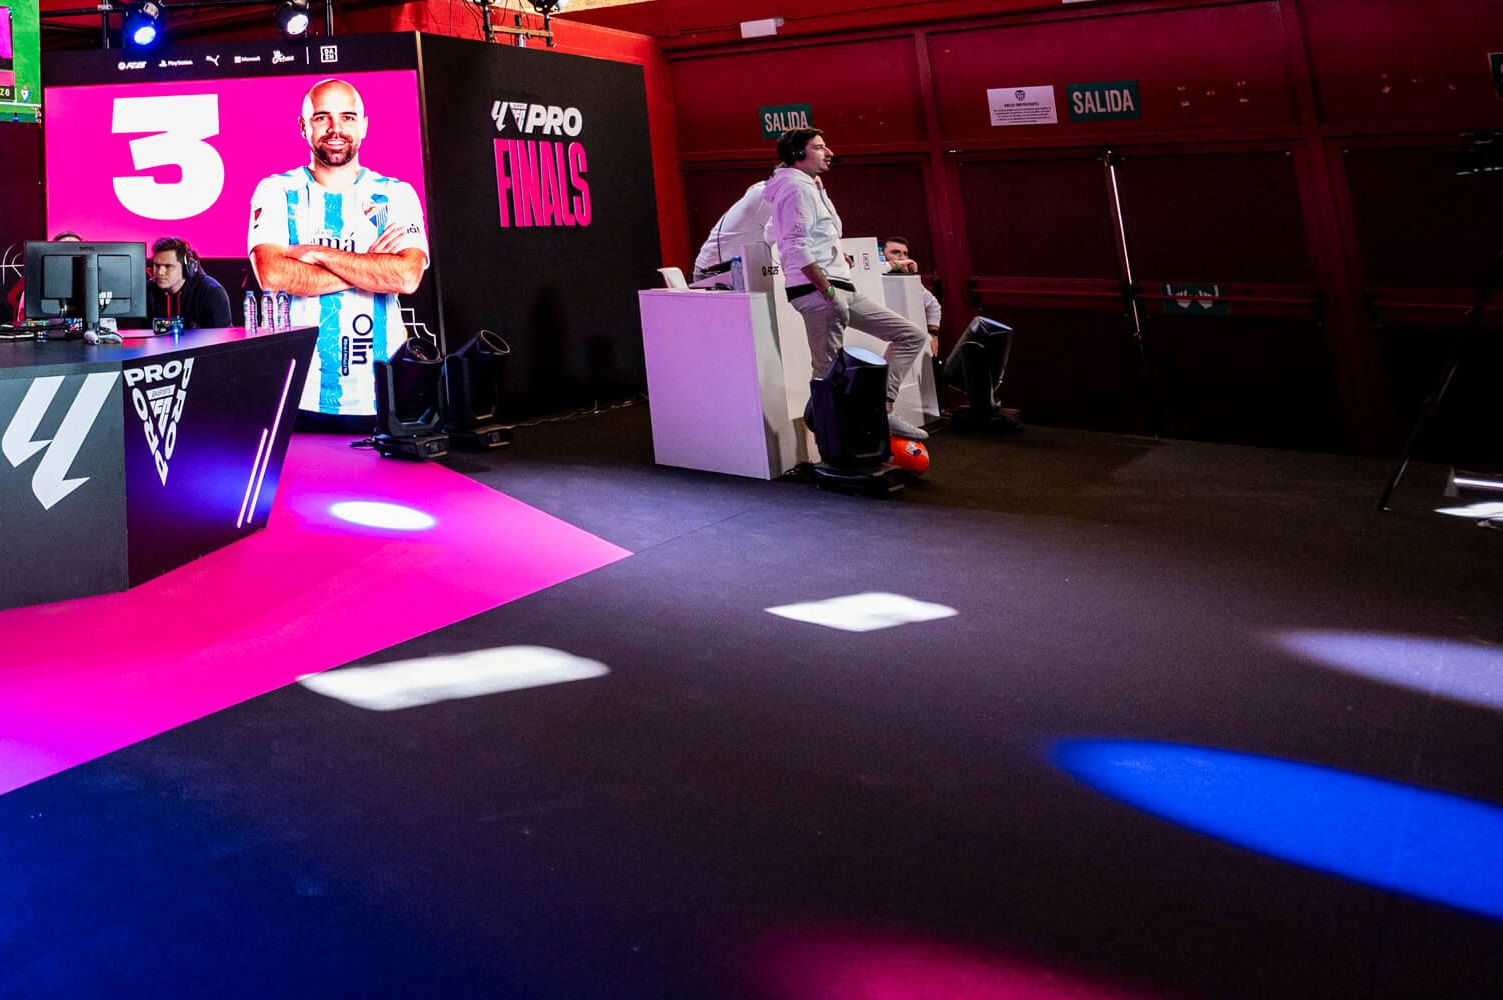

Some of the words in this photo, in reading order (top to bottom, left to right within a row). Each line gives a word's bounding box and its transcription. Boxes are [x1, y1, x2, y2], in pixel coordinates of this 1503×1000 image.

[524, 103, 583, 137] PRO
[764, 110, 809, 132] SALIDA
[1072, 88, 1135, 115] SALIDA
[111, 93, 225, 221] 3
[493, 138, 592, 228] FINALS
[123, 360, 183, 387] PRO
[132, 387, 169, 487] PRO
[165, 357, 194, 460] PRO
